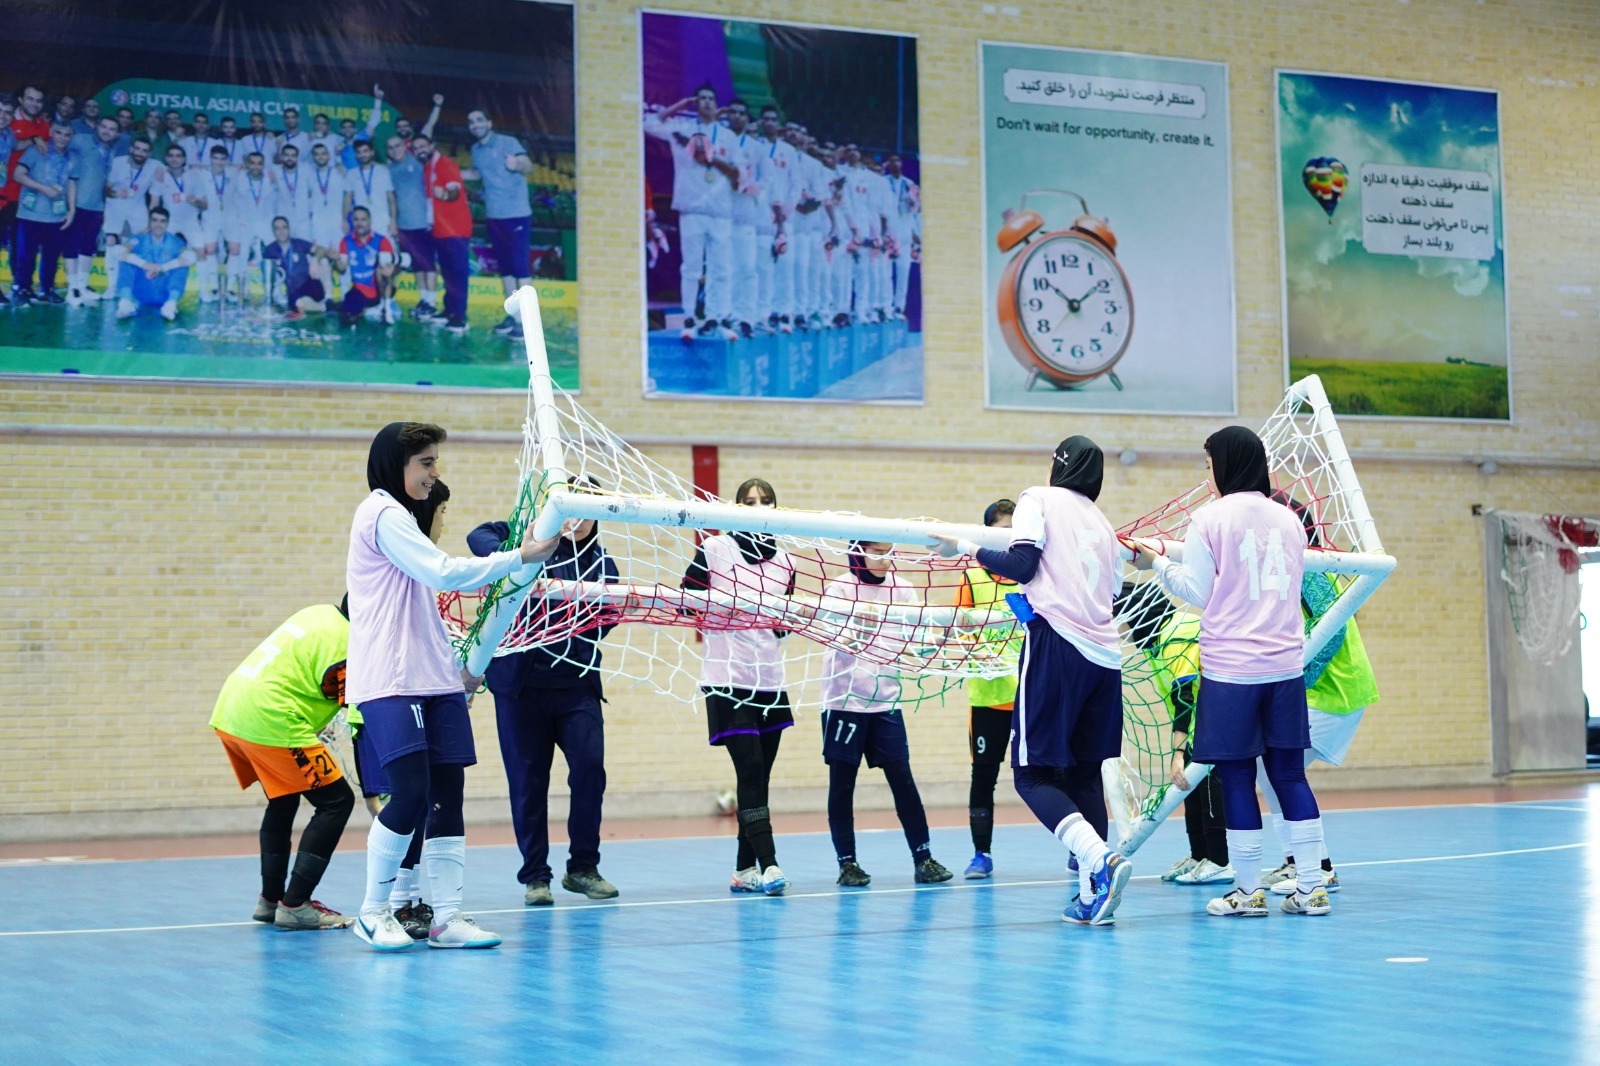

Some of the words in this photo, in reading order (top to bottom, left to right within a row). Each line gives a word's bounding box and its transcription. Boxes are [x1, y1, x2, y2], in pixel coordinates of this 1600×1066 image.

[1044, 82, 1066, 96] خلق
[1069, 84, 1075, 97] را
[1078, 82, 1092, 99] آن
[136, 92, 204, 110] FUTSAL
[206, 97, 260, 113] ASIAN
[1132, 90, 1164, 106] فرصت
[1166, 92, 1195, 107] منتظر
[996, 117, 1031, 131] Don't
[1034, 122, 1060, 134] wait
[1063, 122, 1081, 135] for
[1162, 132, 1200, 145] create
[1203, 134, 1214, 147] it.
[1363, 173, 1388, 187] اندازه
[1389, 176, 1399, 188] به
[1401, 175, 1425, 189] دقیقا
[1426, 178, 1463, 193] موفقیت
[1465, 180, 1489, 192] سقف
[1429, 198, 1454, 208] سقف
[1365, 212, 1394, 224] ذهنت
[1396, 213, 1421, 226] سقف
[1460, 218, 1468, 229] تا
[1470, 224, 1489, 234] پس
[1403, 235, 1423, 248] بساز
[1426, 236, 1443, 248] بلند
[1444, 240, 1454, 252] رو
[1045, 260, 1057, 274] 11
[1061, 254, 1080, 269] 12
[1087, 262, 1094, 276] 1
[1033, 277, 1049, 291] 10
[1096, 279, 1111, 294] 2
[1029, 298, 1043, 312] 9
[1105, 301, 1118, 315] 3
[1037, 319, 1051, 334] 8
[1101, 321, 1113, 335] 4
[1052, 338, 1064, 352] 7
[1070, 345, 1085, 358] 6
[1089, 338, 1102, 352] 5
[1239, 527, 1291, 601] 14
[410, 704, 424, 729] 11
[834, 719, 857, 745] 17
[976, 735, 987, 755] 9
[315, 750, 337, 775] 21
